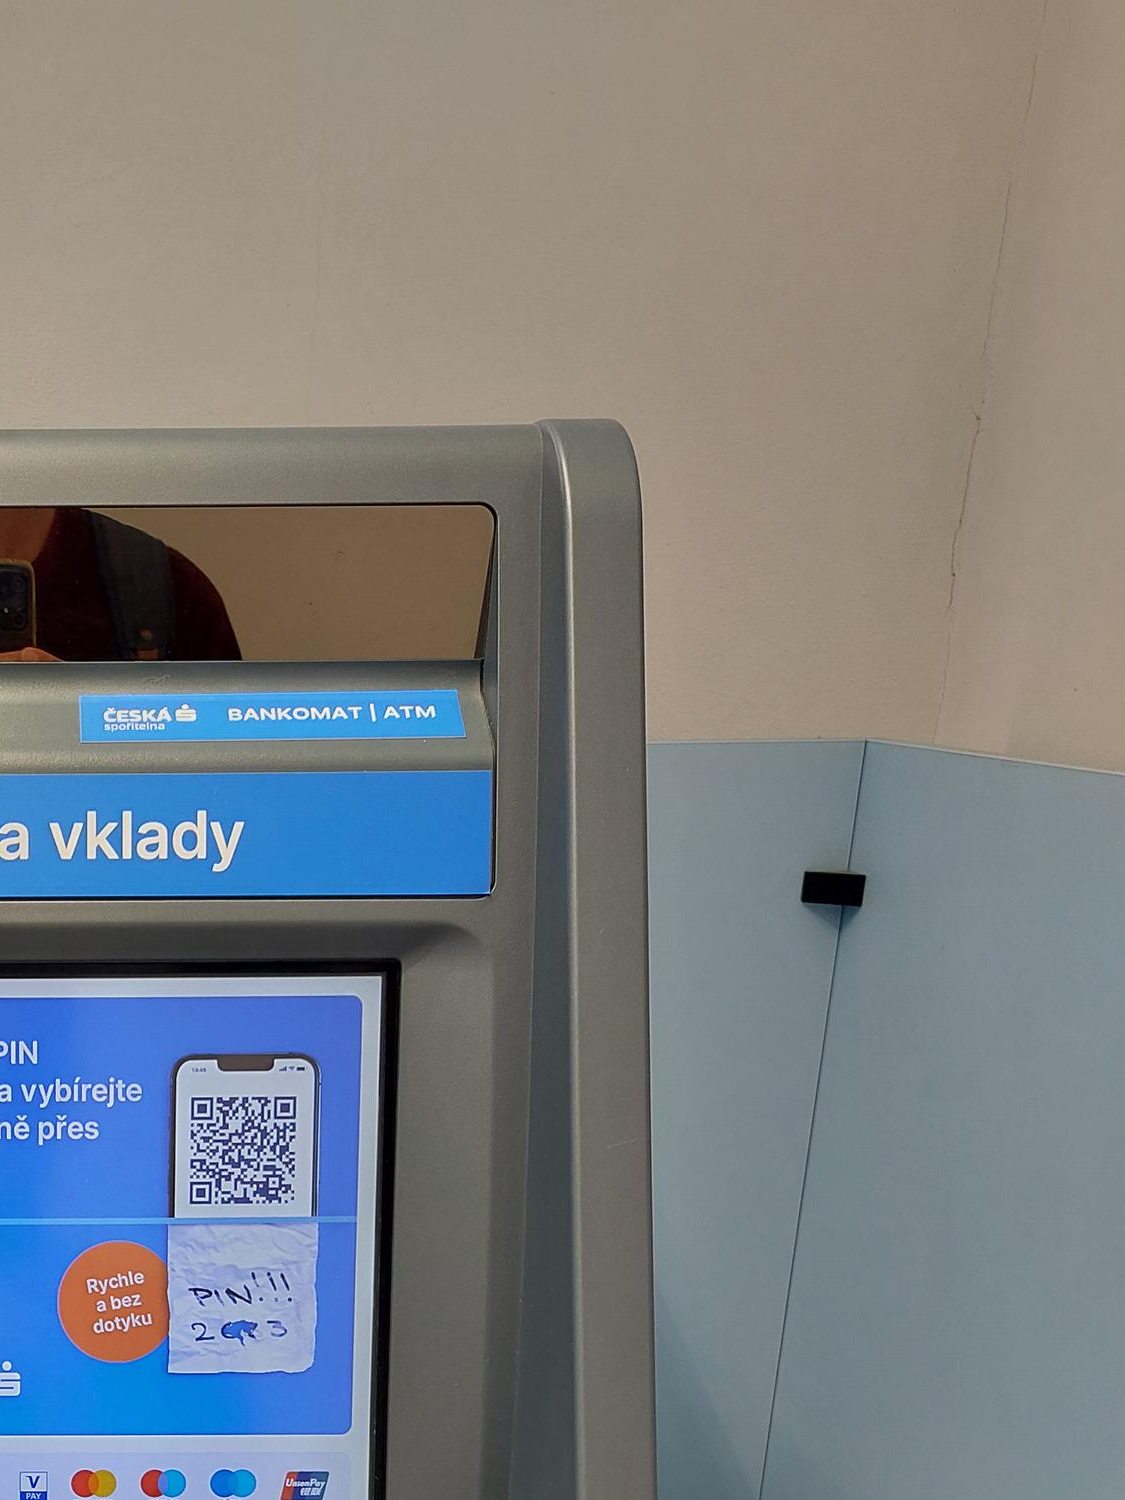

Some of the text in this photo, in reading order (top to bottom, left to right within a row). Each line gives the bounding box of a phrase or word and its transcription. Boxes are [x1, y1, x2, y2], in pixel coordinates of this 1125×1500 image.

[103, 704, 437, 723] ČESKÁ BANKOMAT ATM
[103, 722, 166, 732] spořitelna
[48, 811, 245, 872] vklady
[21, 1077, 143, 1108] vybírejte
[38, 1115, 100, 1146] přes
[86, 1270, 145, 1295] Rychle
[96, 1293, 142, 1313] a bez
[92, 1311, 153, 1335] dotyku
[25, 1492, 42, 1500] PAY
